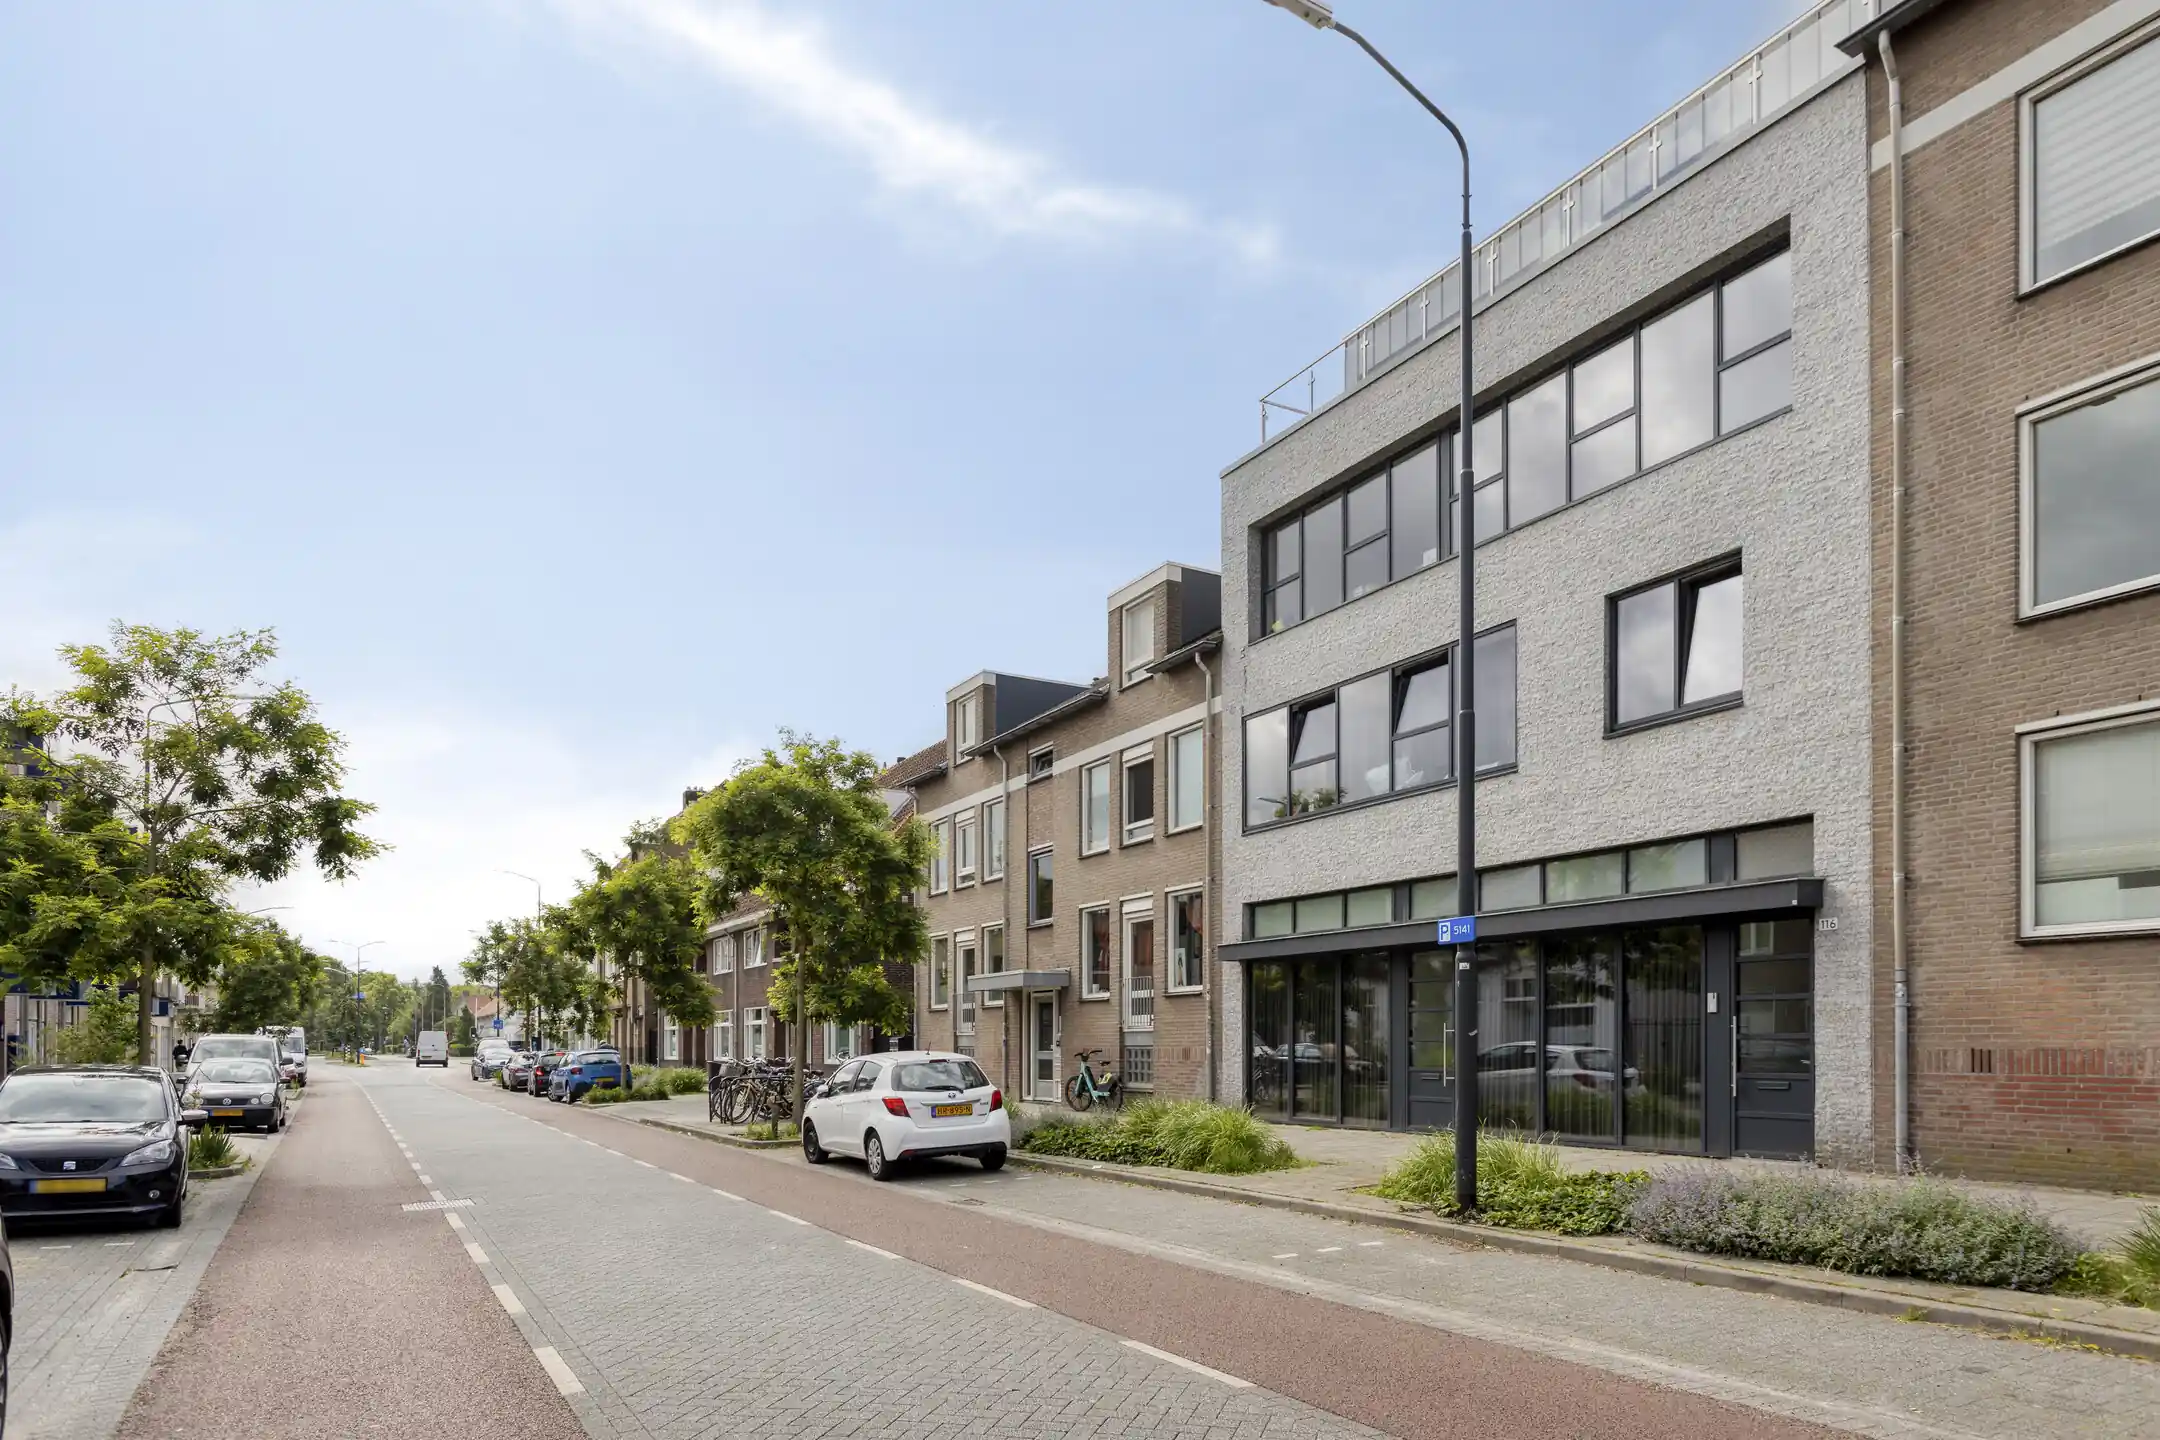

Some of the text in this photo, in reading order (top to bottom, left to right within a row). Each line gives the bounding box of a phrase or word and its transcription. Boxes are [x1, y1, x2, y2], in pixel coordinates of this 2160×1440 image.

[1820, 919, 1836, 929] 116
[1440, 923, 1470, 941] P 5141
